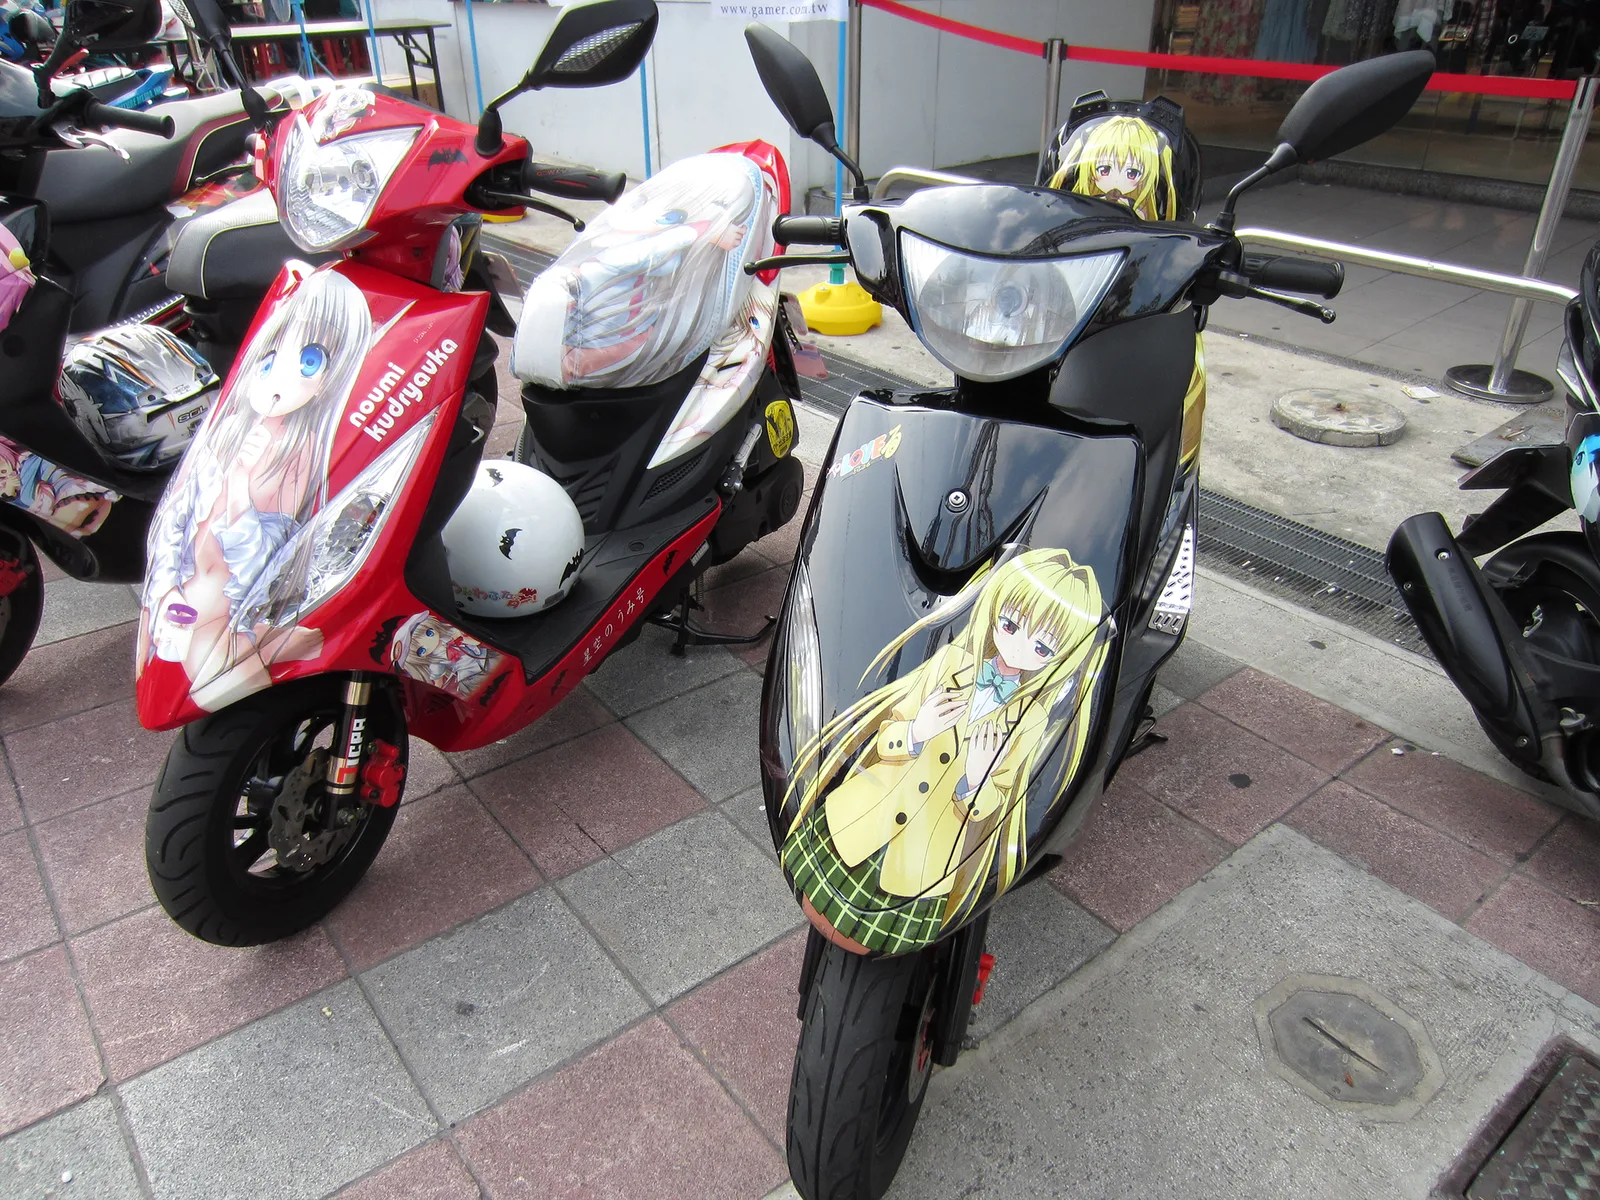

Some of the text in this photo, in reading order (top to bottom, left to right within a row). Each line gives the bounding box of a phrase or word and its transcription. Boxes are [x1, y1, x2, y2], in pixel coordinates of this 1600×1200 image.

[177, 405, 208, 424] SOL
[349, 362, 406, 428] noumi
[363, 338, 458, 442] kudryavka
